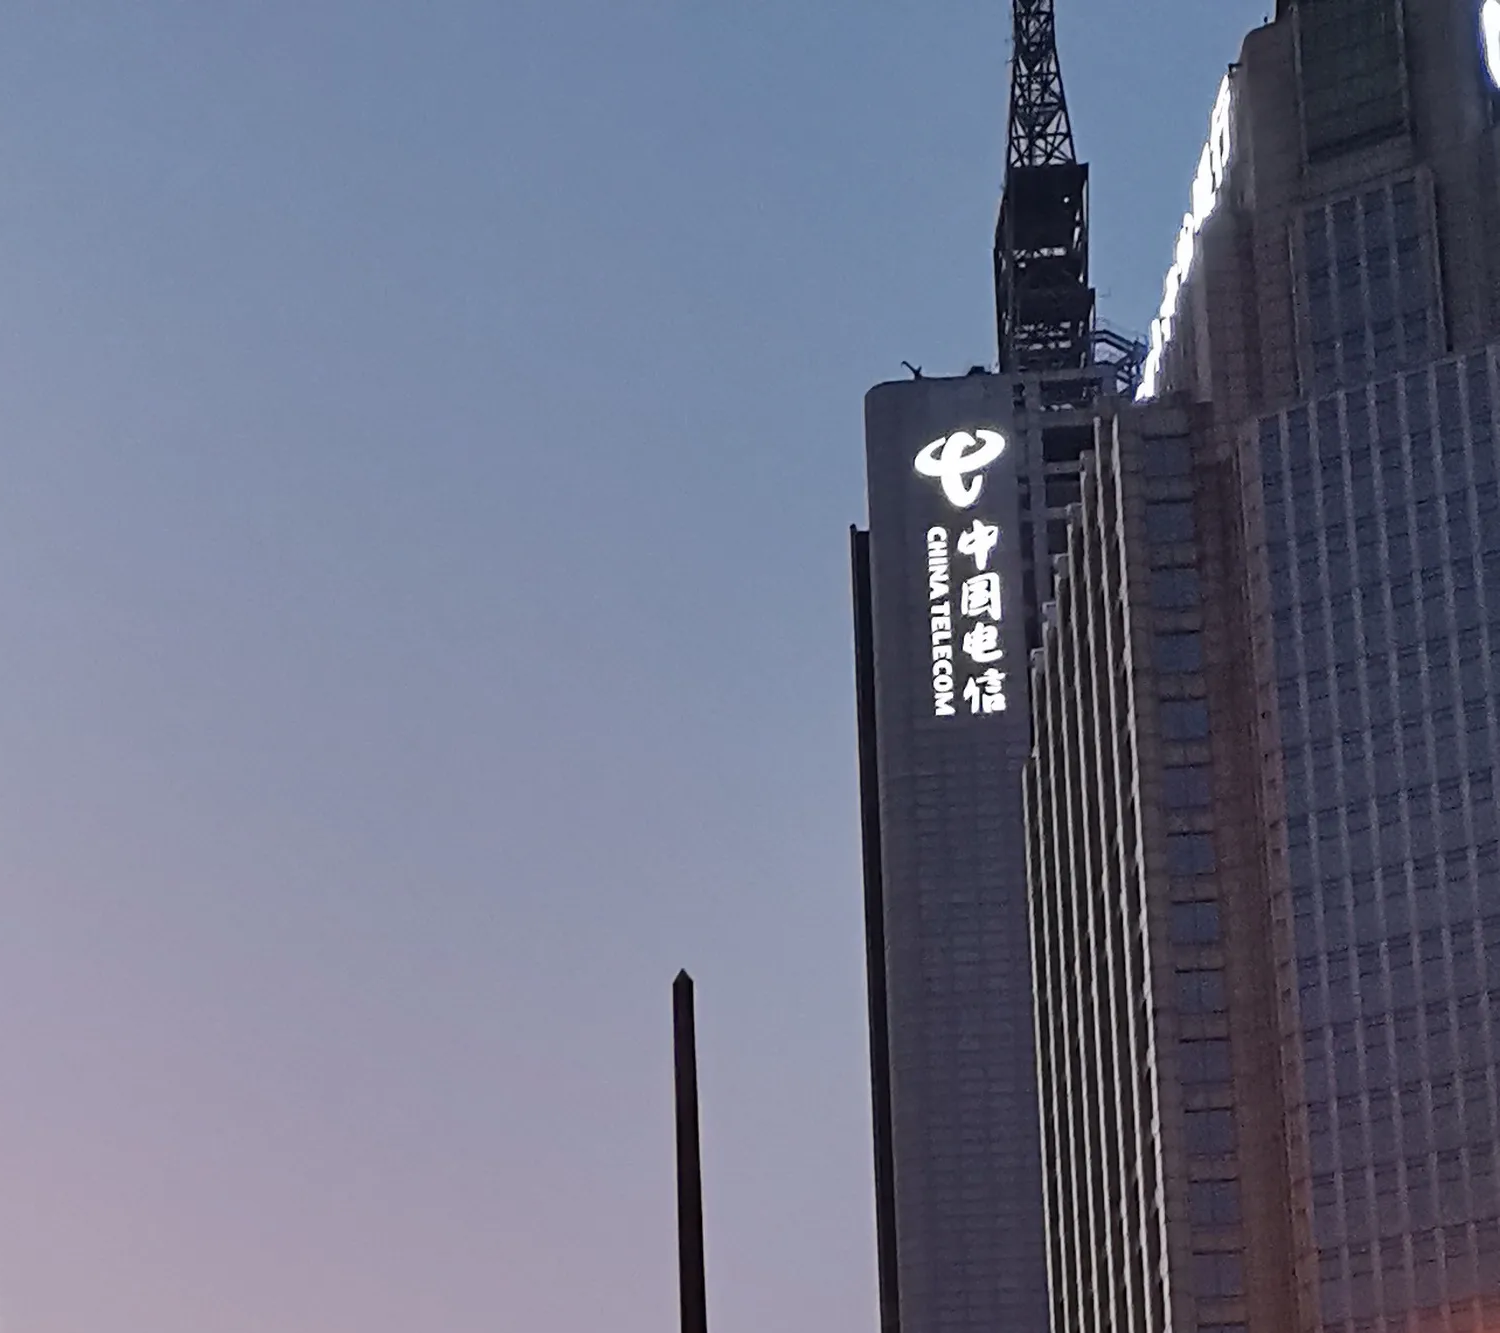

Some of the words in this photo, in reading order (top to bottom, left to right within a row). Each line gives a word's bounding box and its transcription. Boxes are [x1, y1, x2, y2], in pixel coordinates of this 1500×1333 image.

[926, 526, 950, 600] CHINA
[957, 518, 1007, 715] 中国电信
[930, 600, 956, 717] TELECOM
